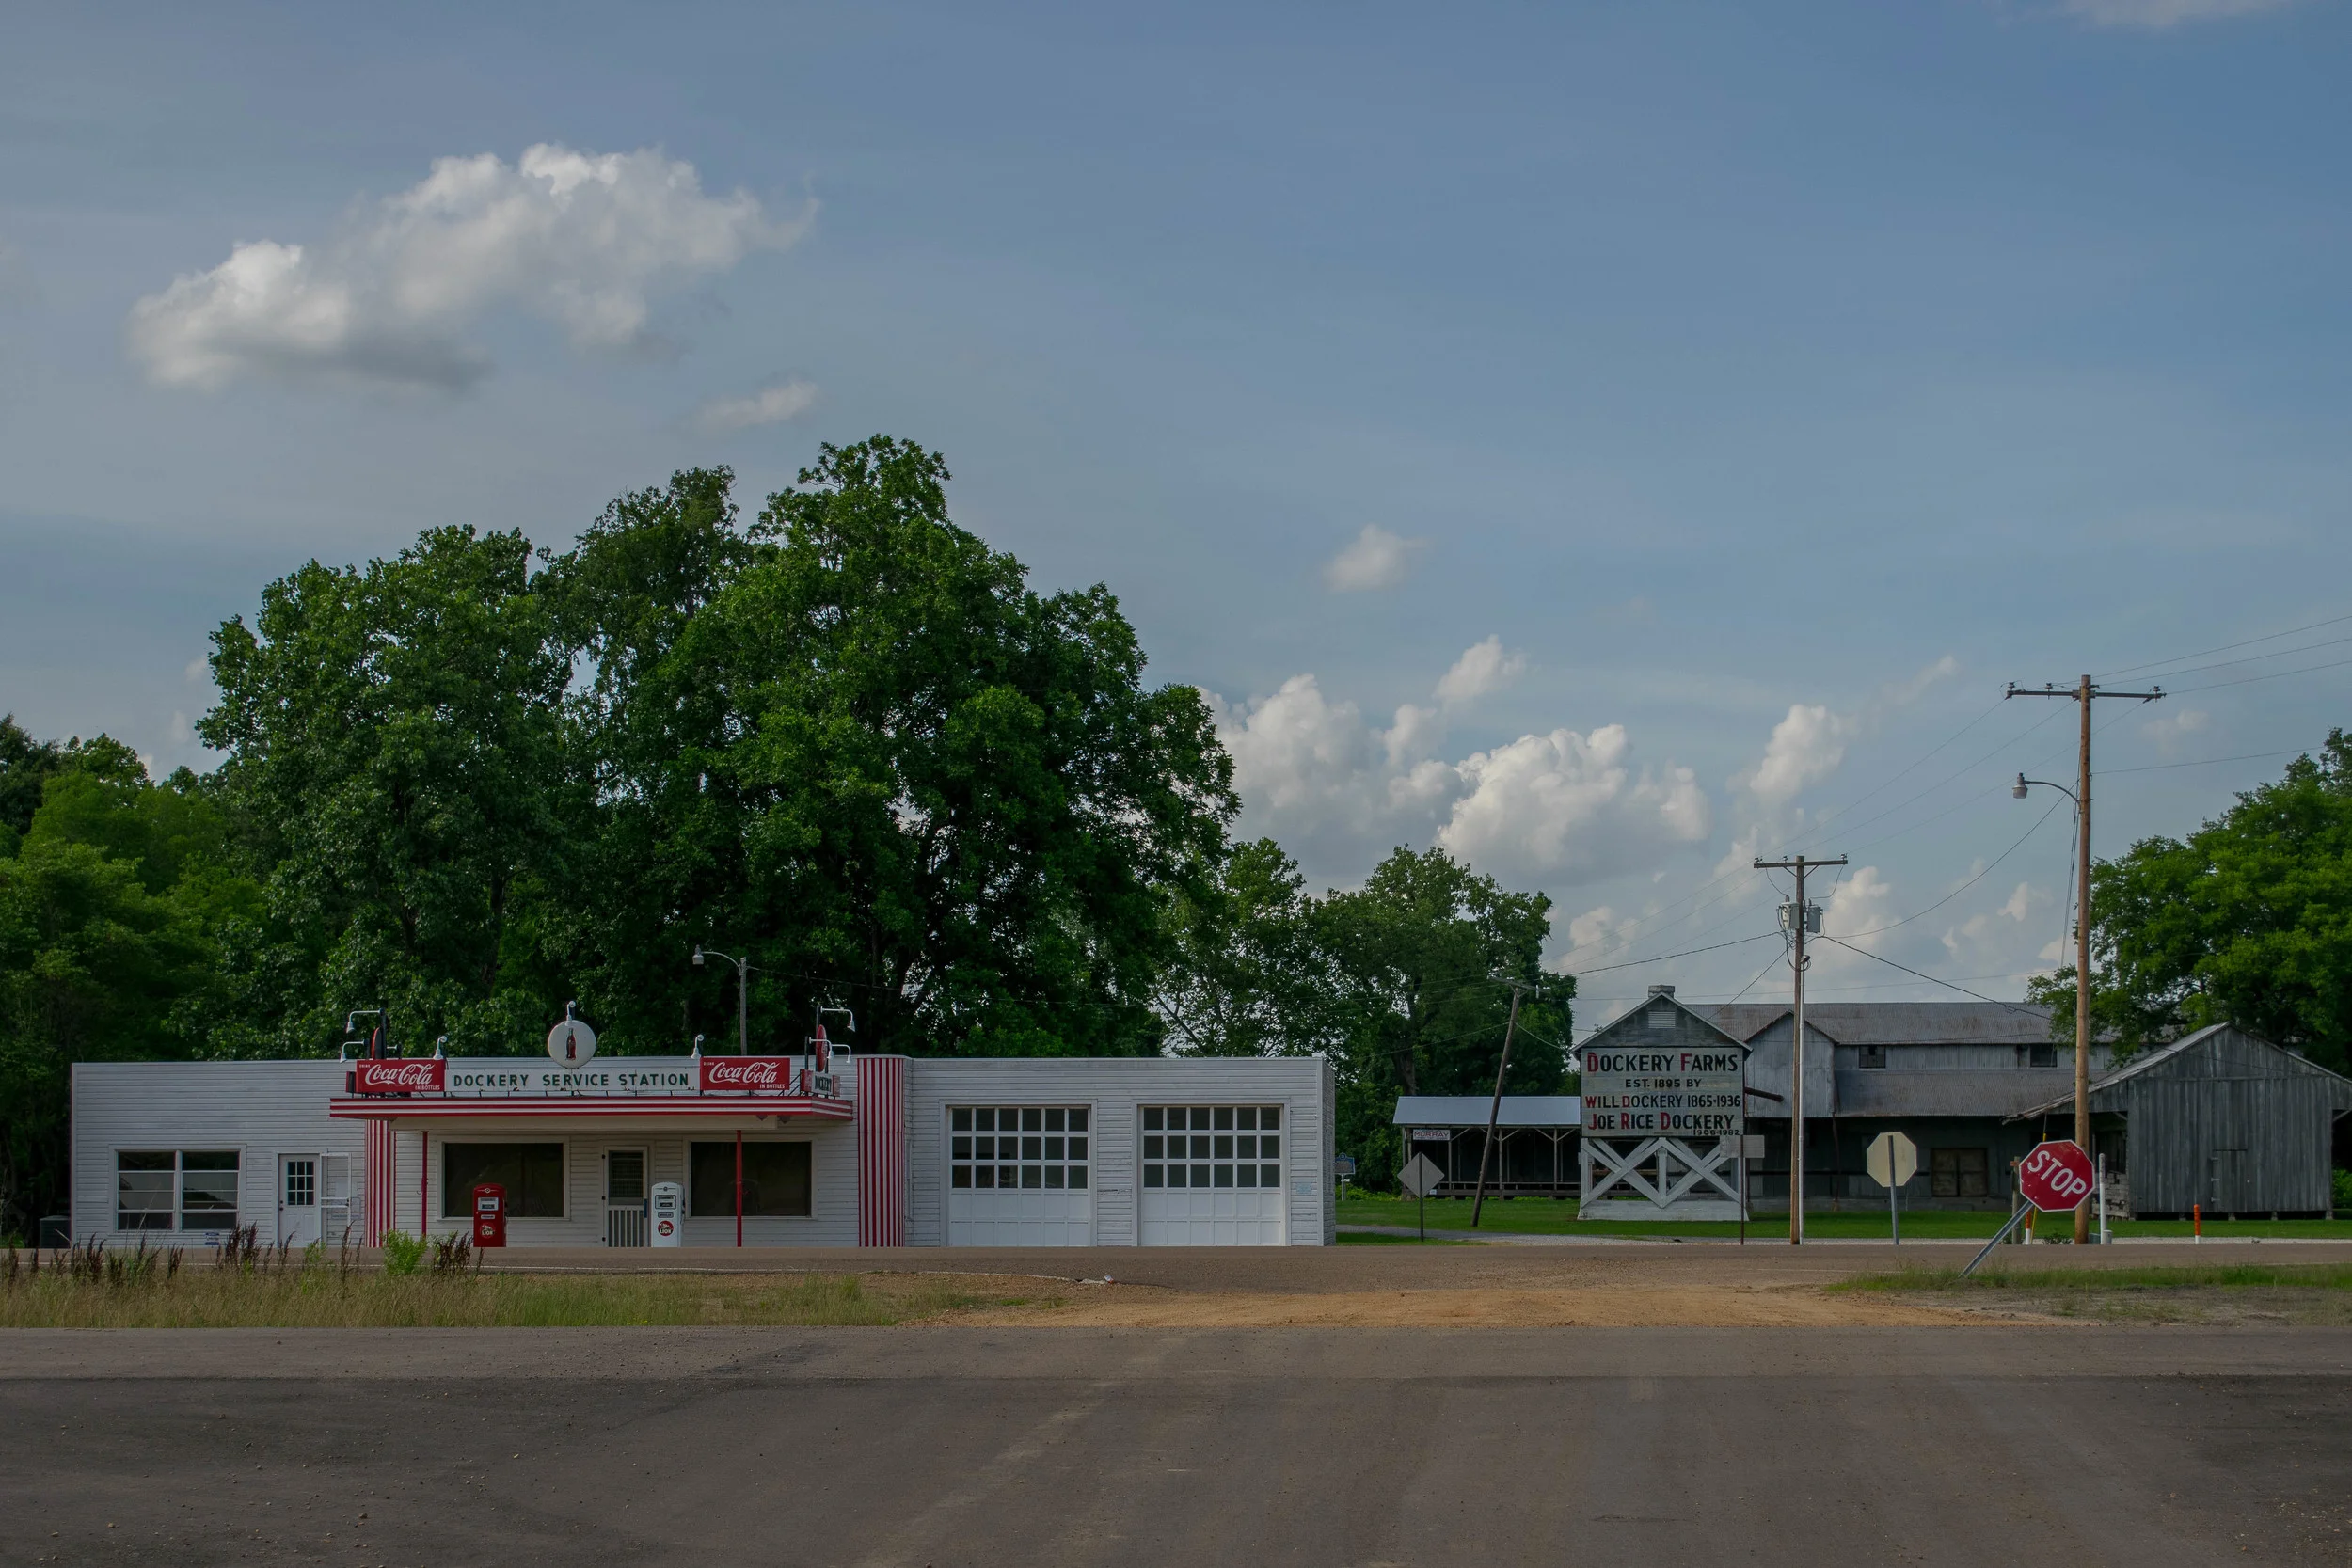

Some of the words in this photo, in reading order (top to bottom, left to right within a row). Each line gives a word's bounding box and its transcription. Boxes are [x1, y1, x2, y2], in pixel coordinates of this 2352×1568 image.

[1587, 1053, 1674, 1072] DOCKERY
[1680, 1053, 1738, 1072] FARMS
[365, 1064, 436, 1085] Coca-Cola
[453, 1074, 529, 1087] DOCKERY
[542, 1073, 609, 1086] SERVICE
[618, 1073, 689, 1086] STATION
[709, 1062, 781, 1084] Coca-Cola
[1625, 1079, 1650, 1088] EST.
[1654, 1079, 1681, 1088] 1895
[1686, 1079, 1702, 1088] BY
[1585, 1096, 1620, 1108] WILL
[1622, 1095, 1683, 1108] DOCKERY
[1588, 1113, 1615, 1131] JOE
[1621, 1112, 1654, 1130] RICE
[1660, 1112, 1735, 1130] DOCKERY
[2027, 1150, 2087, 1197] STOP
